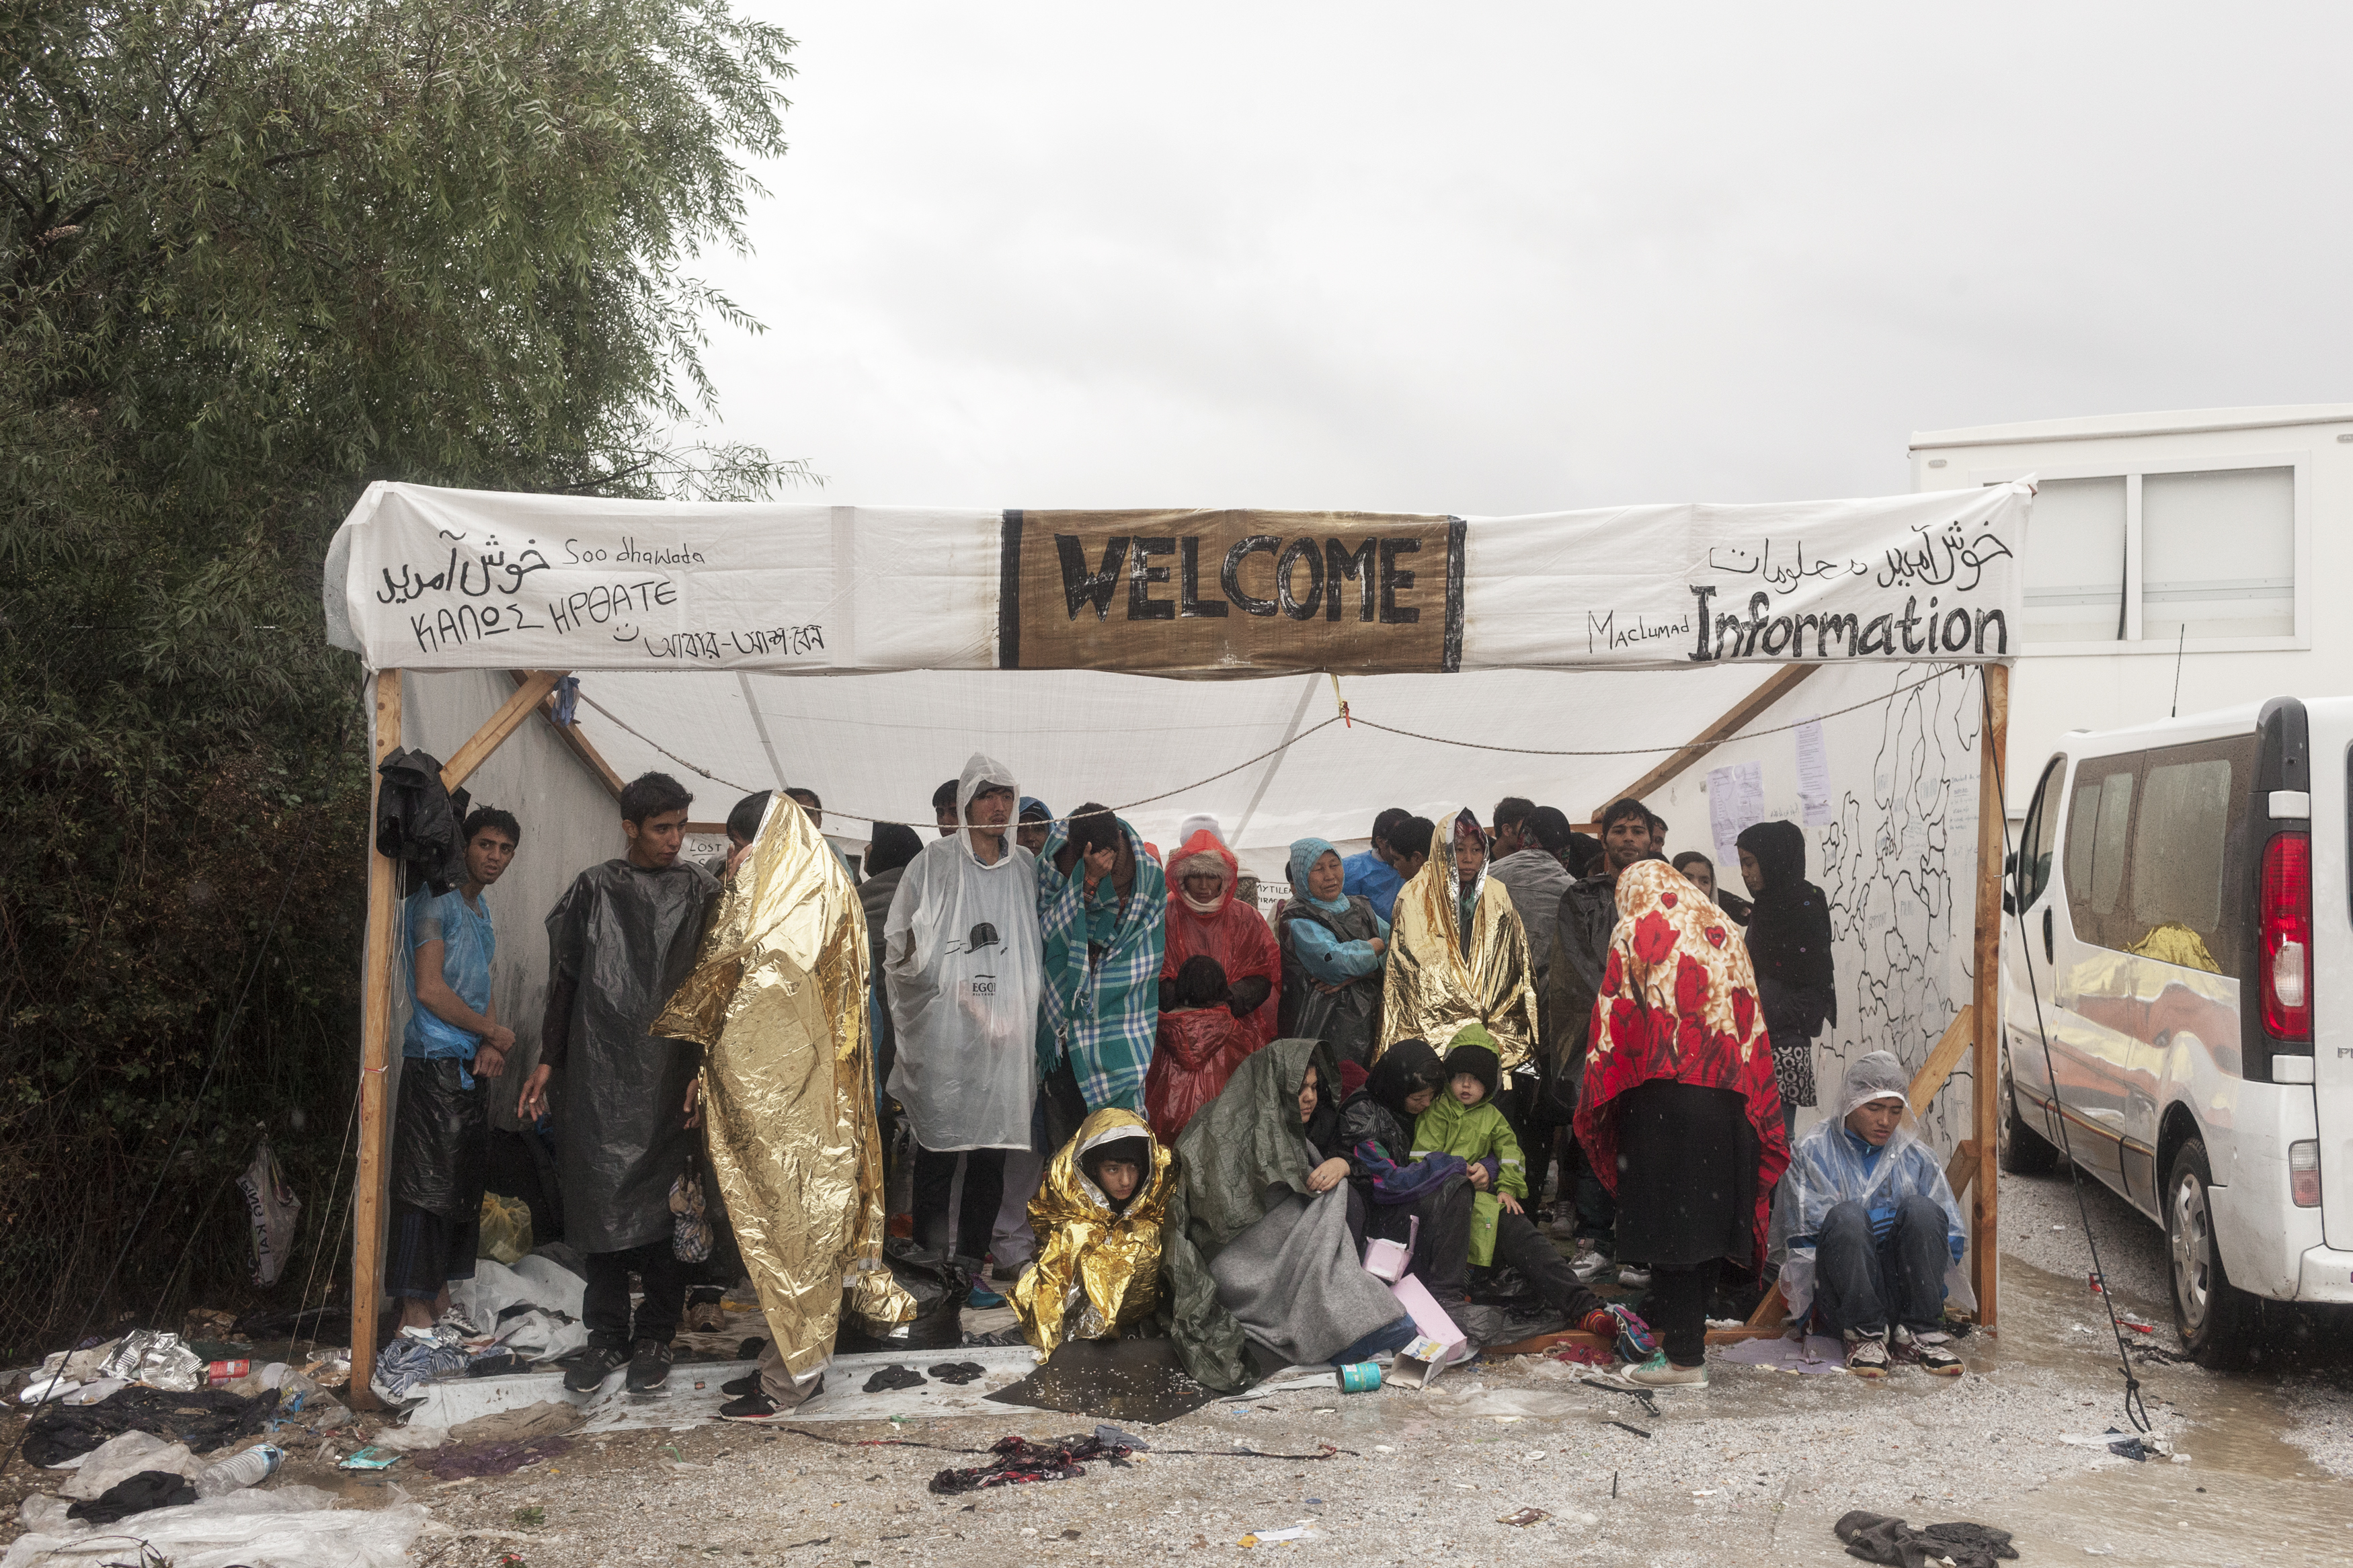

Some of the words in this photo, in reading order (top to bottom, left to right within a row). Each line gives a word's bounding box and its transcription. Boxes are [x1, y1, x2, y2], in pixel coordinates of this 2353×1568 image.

[563, 538, 607, 565] Soo
[1054, 533, 1422, 622] WELCOME
[1688, 584, 2008, 661] Information
[690, 839, 722, 852] LOST
